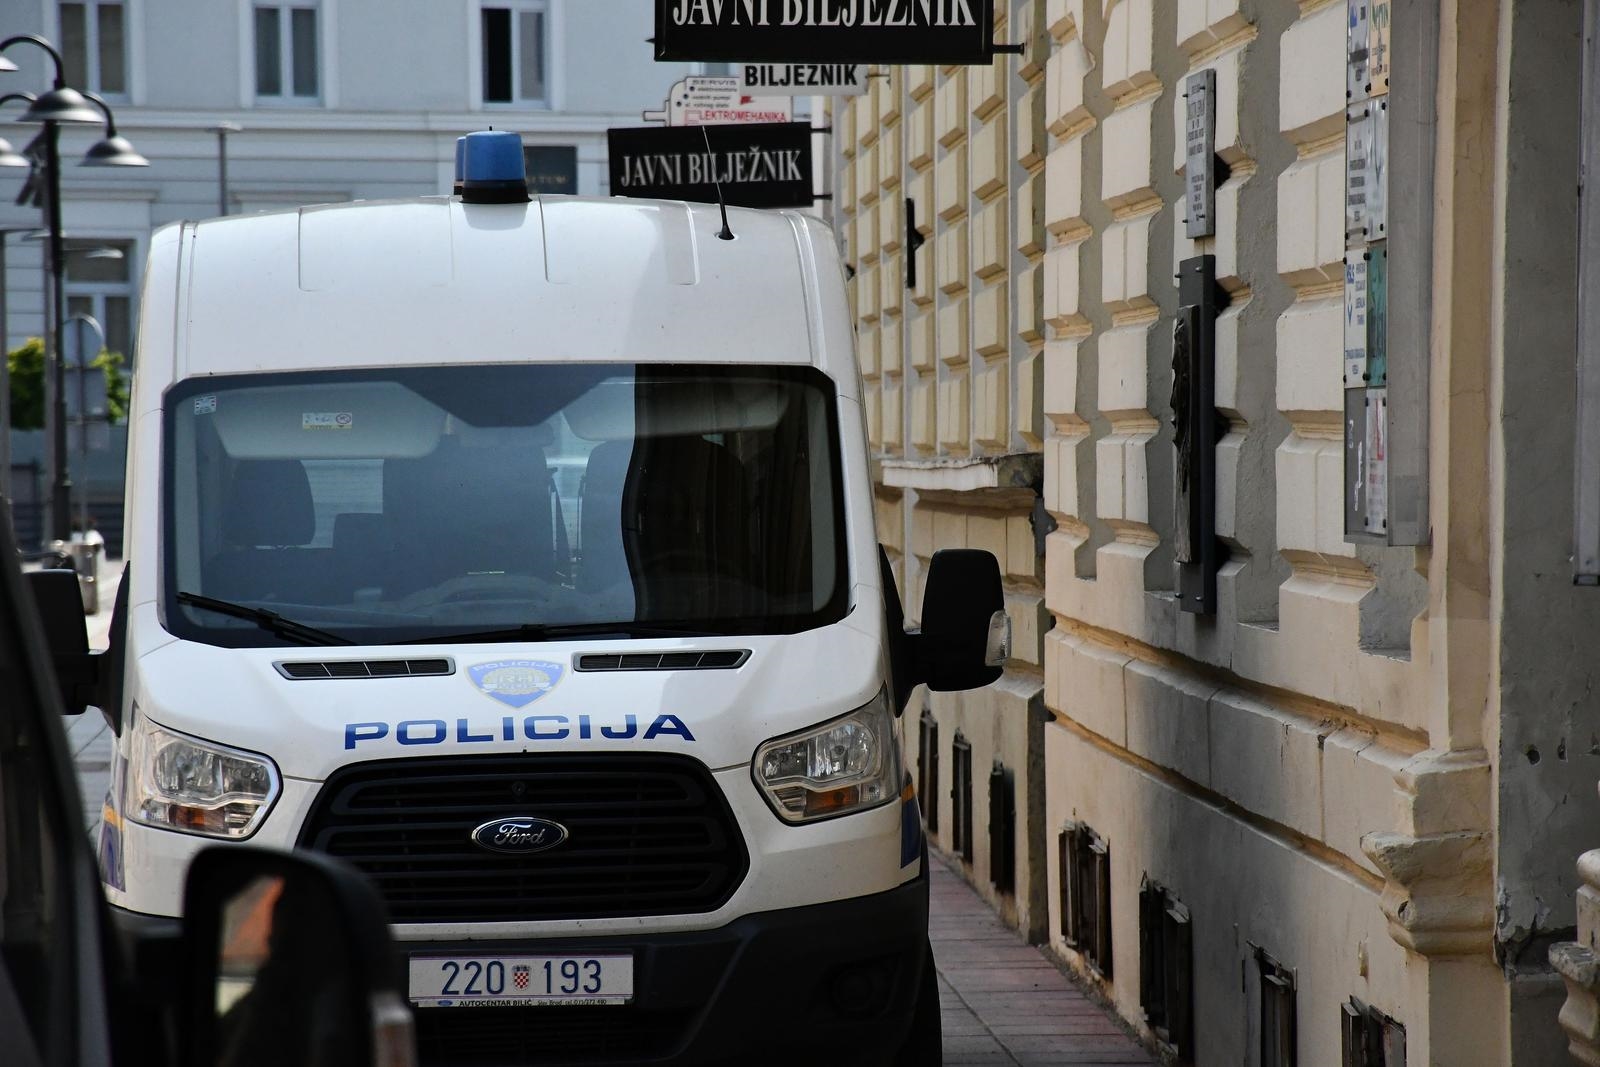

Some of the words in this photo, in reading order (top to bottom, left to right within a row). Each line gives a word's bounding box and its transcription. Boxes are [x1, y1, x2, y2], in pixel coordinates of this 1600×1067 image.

[621, 155, 682, 187] JAVNI
[688, 145, 802, 185] BILJEŽNIK
[472, 661, 559, 671] POLICIJA
[344, 714, 696, 750] POLICIJA
[494, 823, 546, 846] Ford
[441, 960, 505, 995] 220
[543, 959, 602, 994] 193
